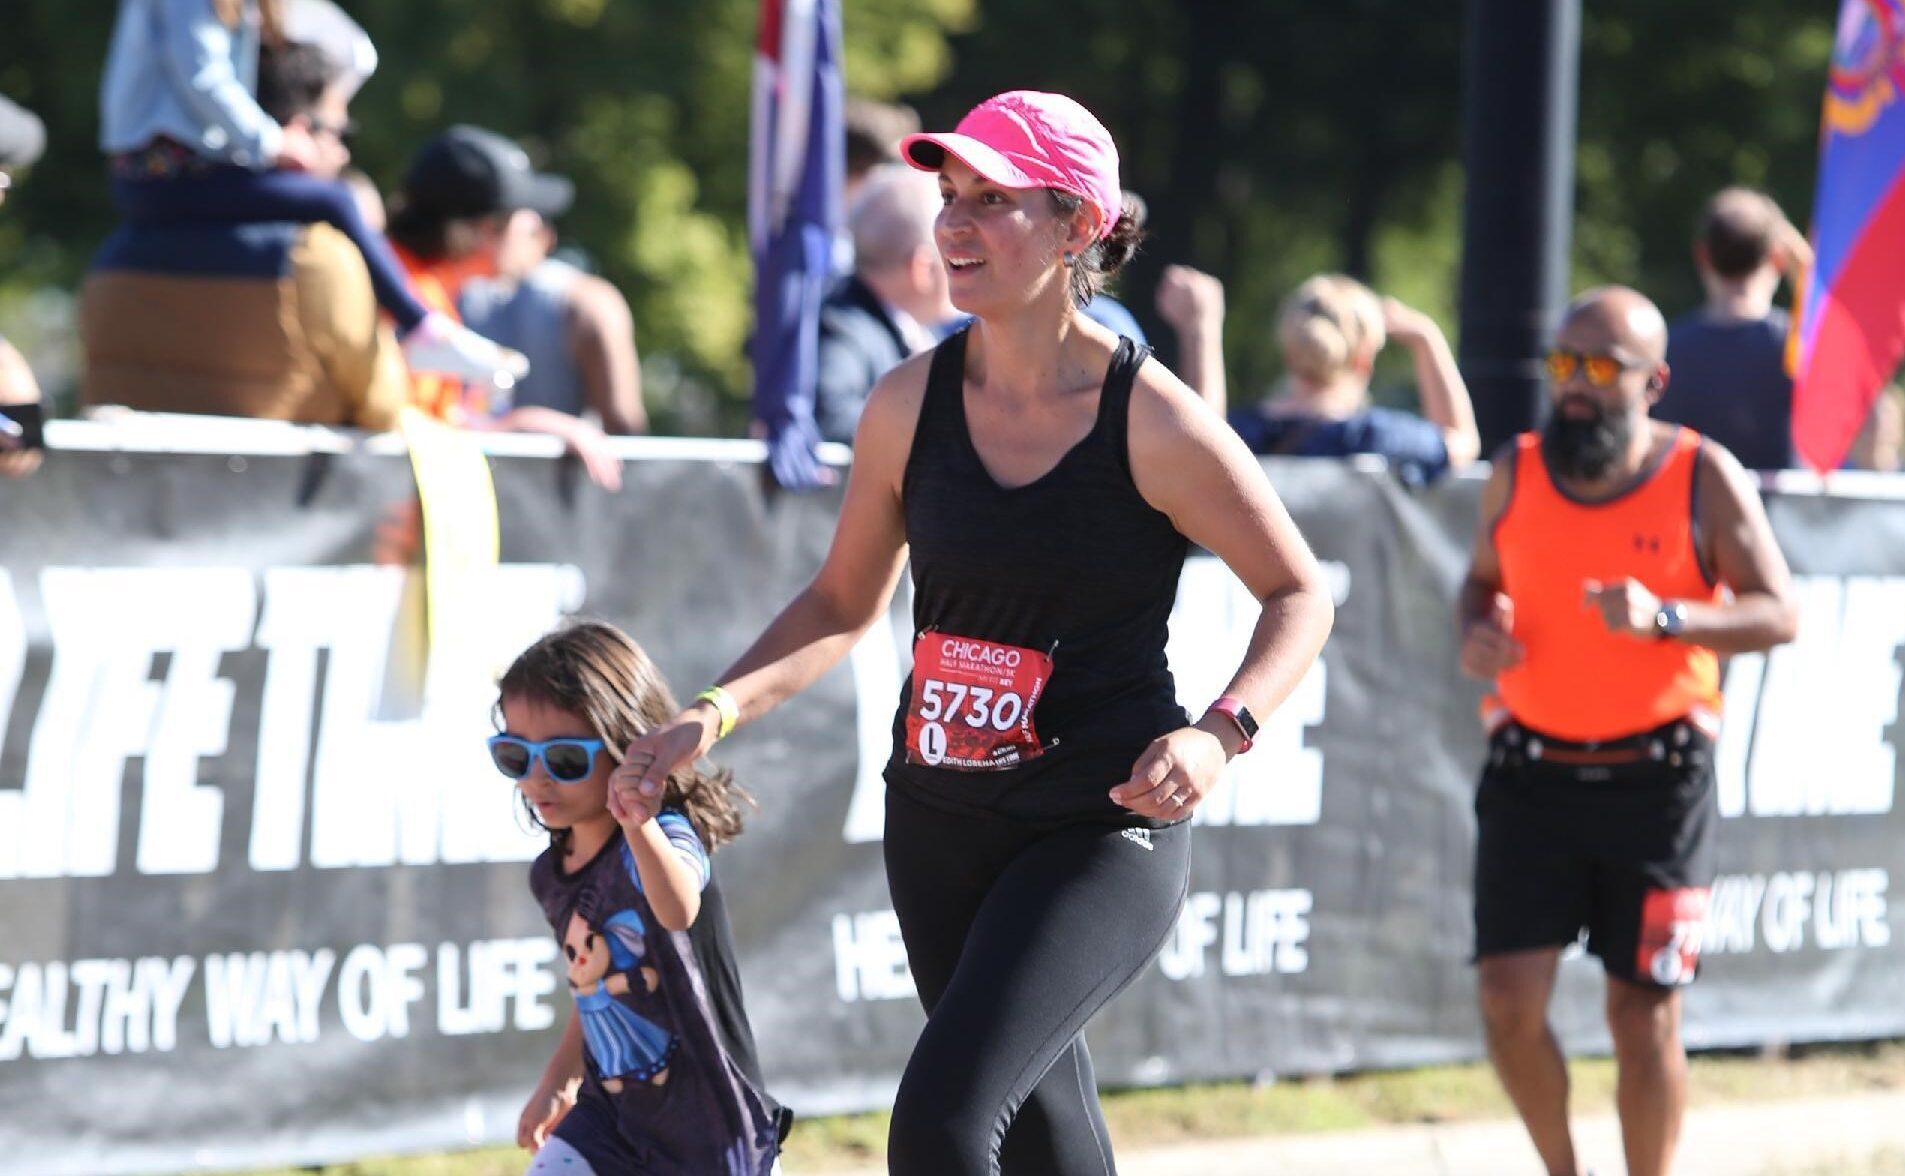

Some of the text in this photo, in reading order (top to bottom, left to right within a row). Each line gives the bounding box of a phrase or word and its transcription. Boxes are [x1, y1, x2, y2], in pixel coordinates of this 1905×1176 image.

[941, 639, 1020, 668] CHICAGO
[919, 679, 1022, 731] 5730
[928, 727, 938, 755] L
[1222, 888, 1314, 977] LIFE
[1761, 870, 1816, 953] OF
[1813, 867, 1891, 950] LIFE
[205, 947, 337, 1048] WAY
[338, 942, 429, 1042] OF
[436, 936, 558, 1036] LIFE
